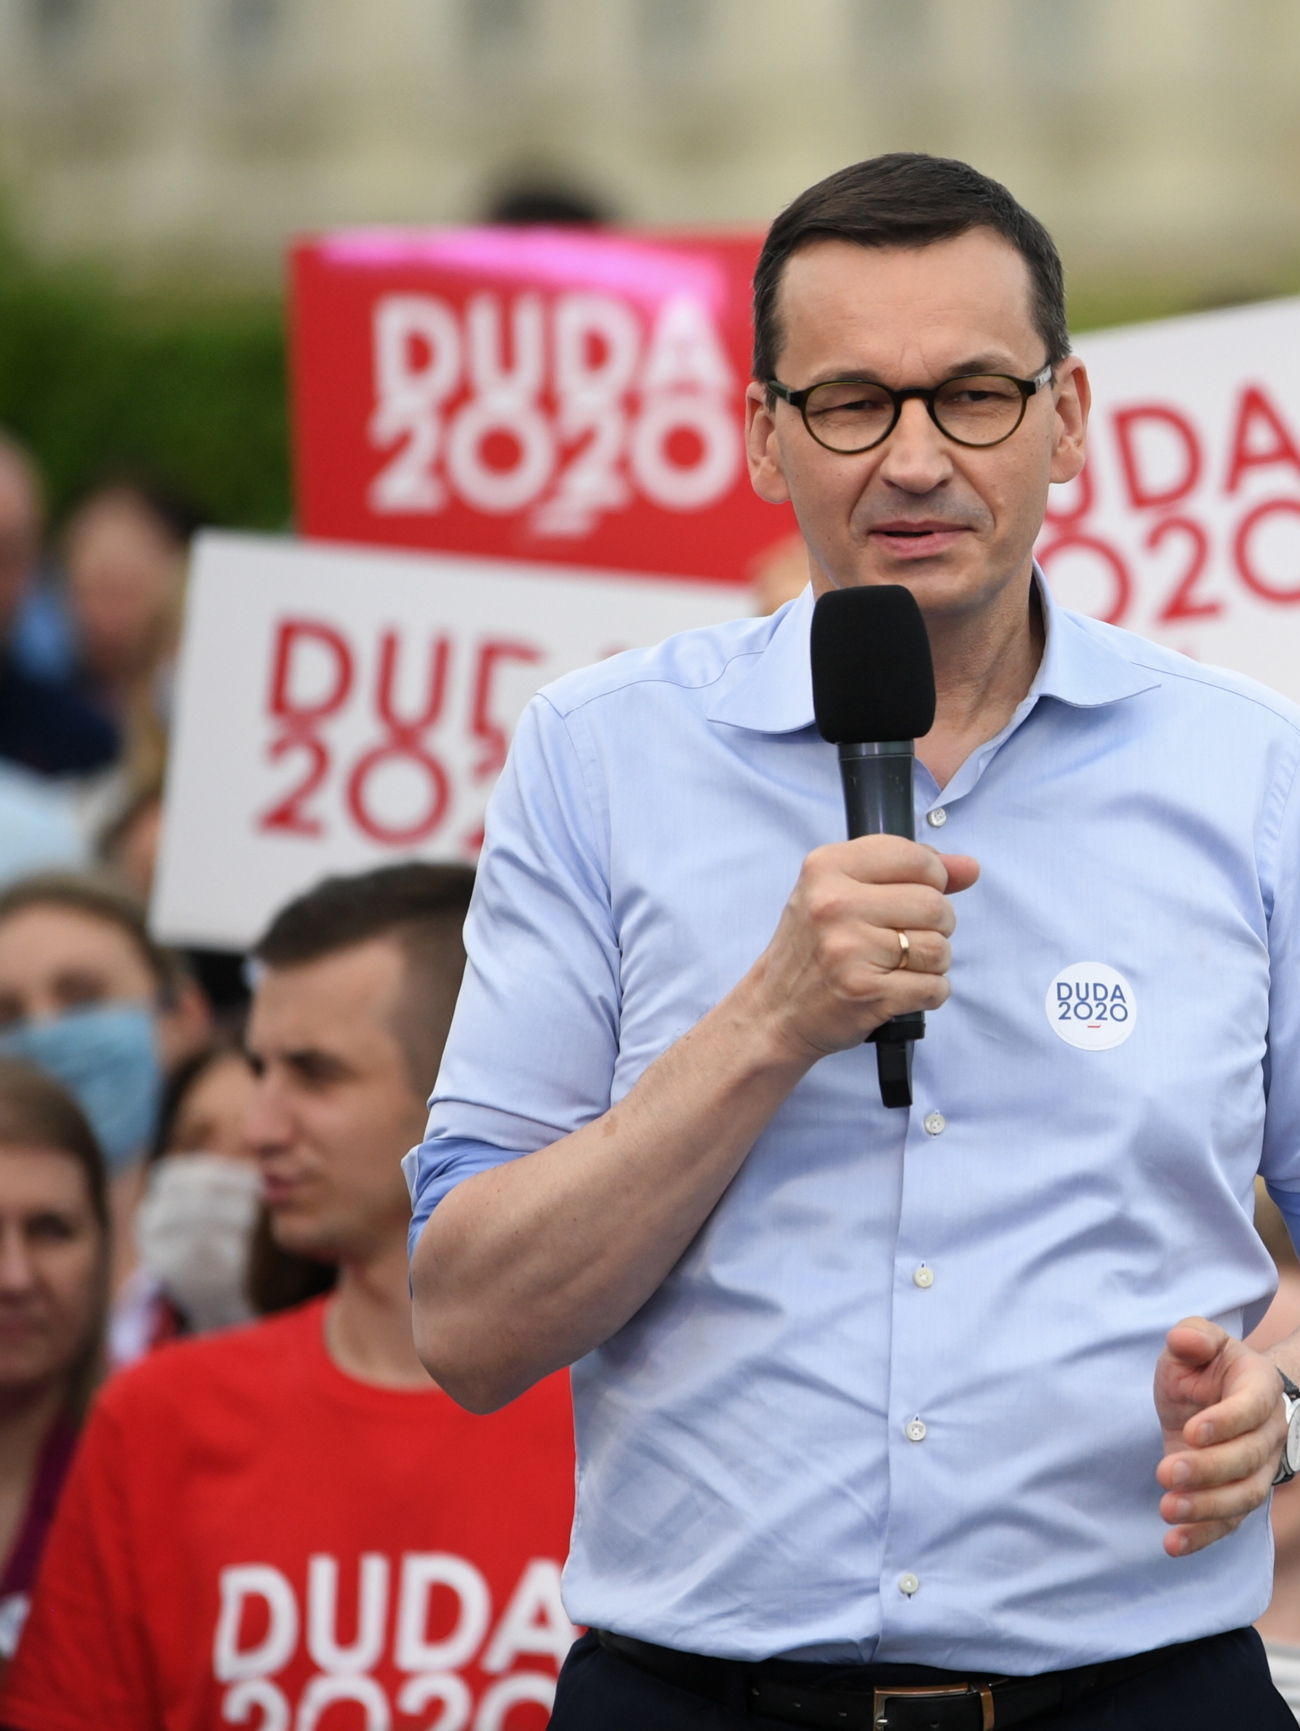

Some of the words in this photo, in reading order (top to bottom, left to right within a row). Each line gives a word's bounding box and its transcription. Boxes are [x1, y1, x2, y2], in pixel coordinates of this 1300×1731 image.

[373, 292, 732, 403] DUDA
[368, 398, 743, 516] 2020
[267, 614, 548, 738] DUD
[255, 731, 512, 857] 20
[1056, 982, 1127, 1004] DUDA
[1057, 1001, 1129, 1023] 2020
[214, 1553, 580, 1684] DUDA
